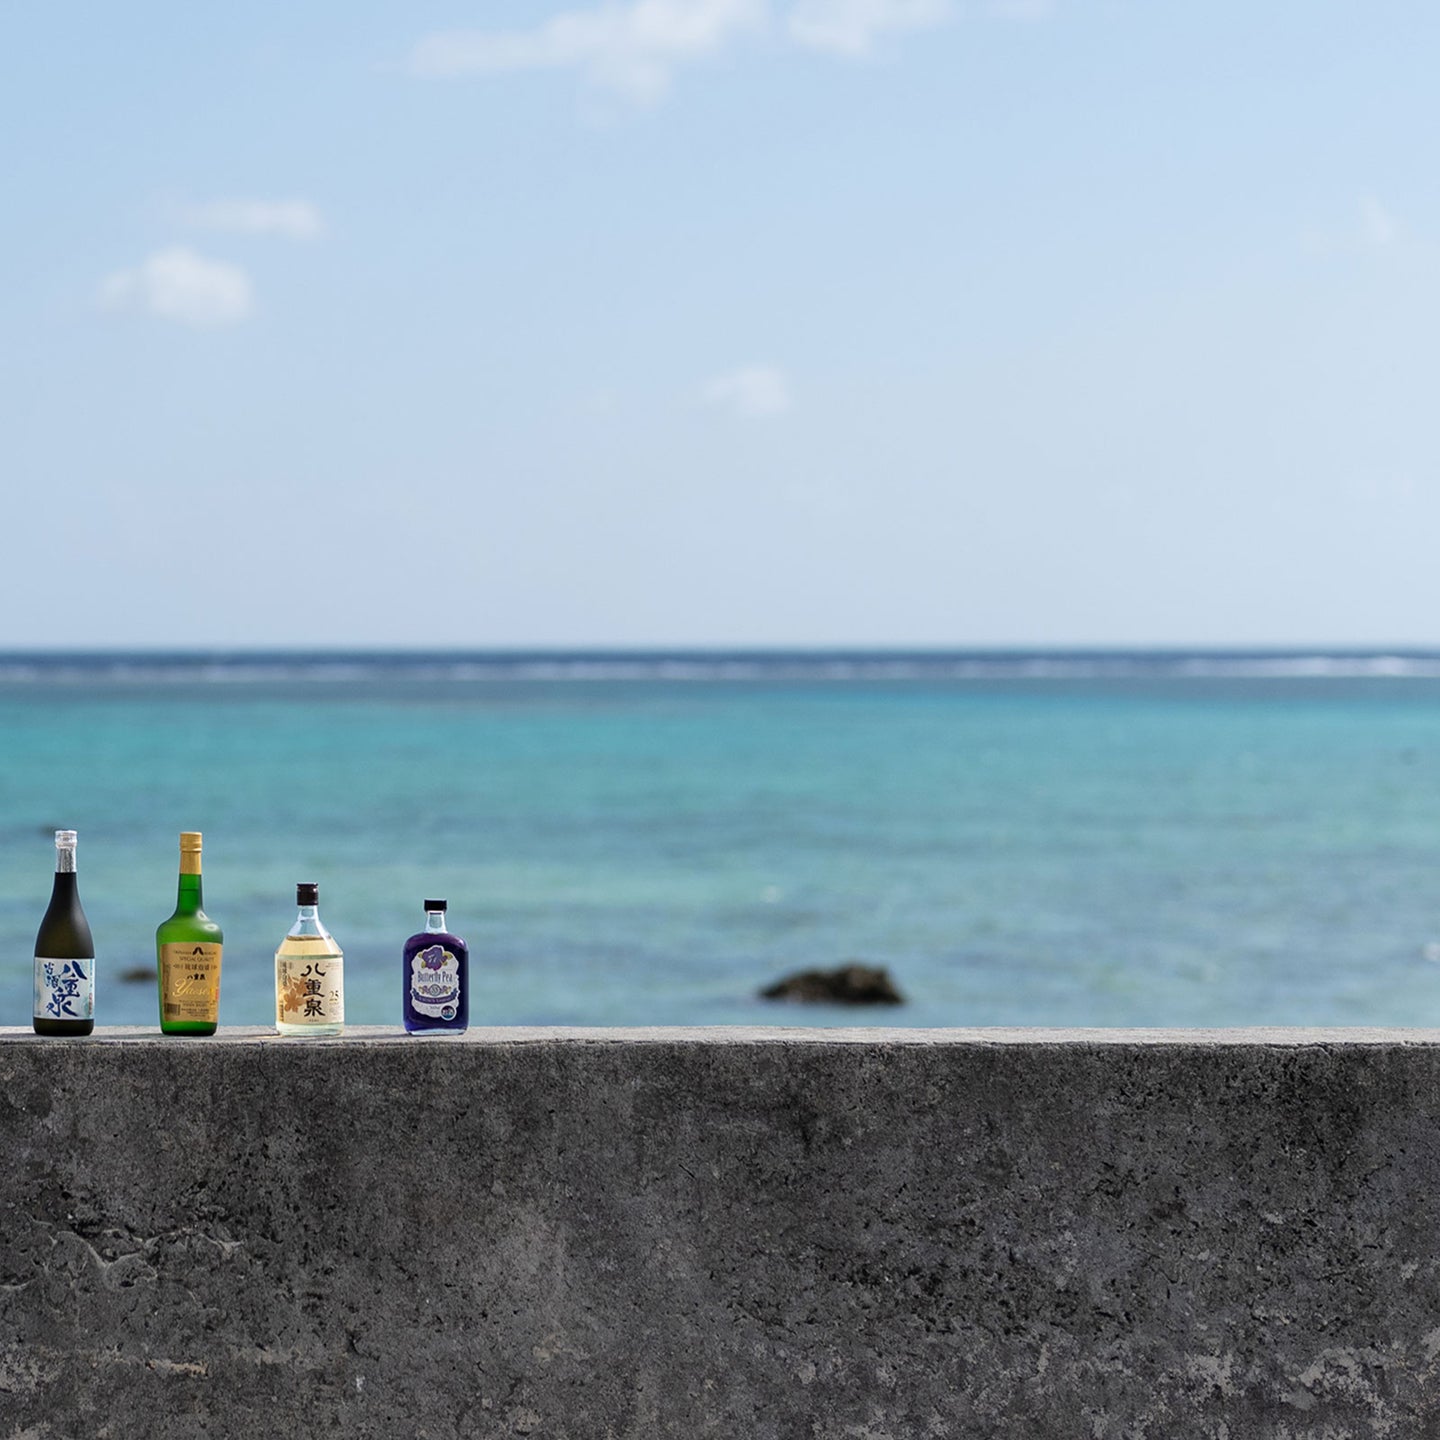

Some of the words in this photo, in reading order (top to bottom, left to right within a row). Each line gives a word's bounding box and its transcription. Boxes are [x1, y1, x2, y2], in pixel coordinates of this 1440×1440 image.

[46, 960, 88, 1017] 八重泉
[300, 963, 326, 1017] 八重泉
[442, 971, 453, 983] Pea
